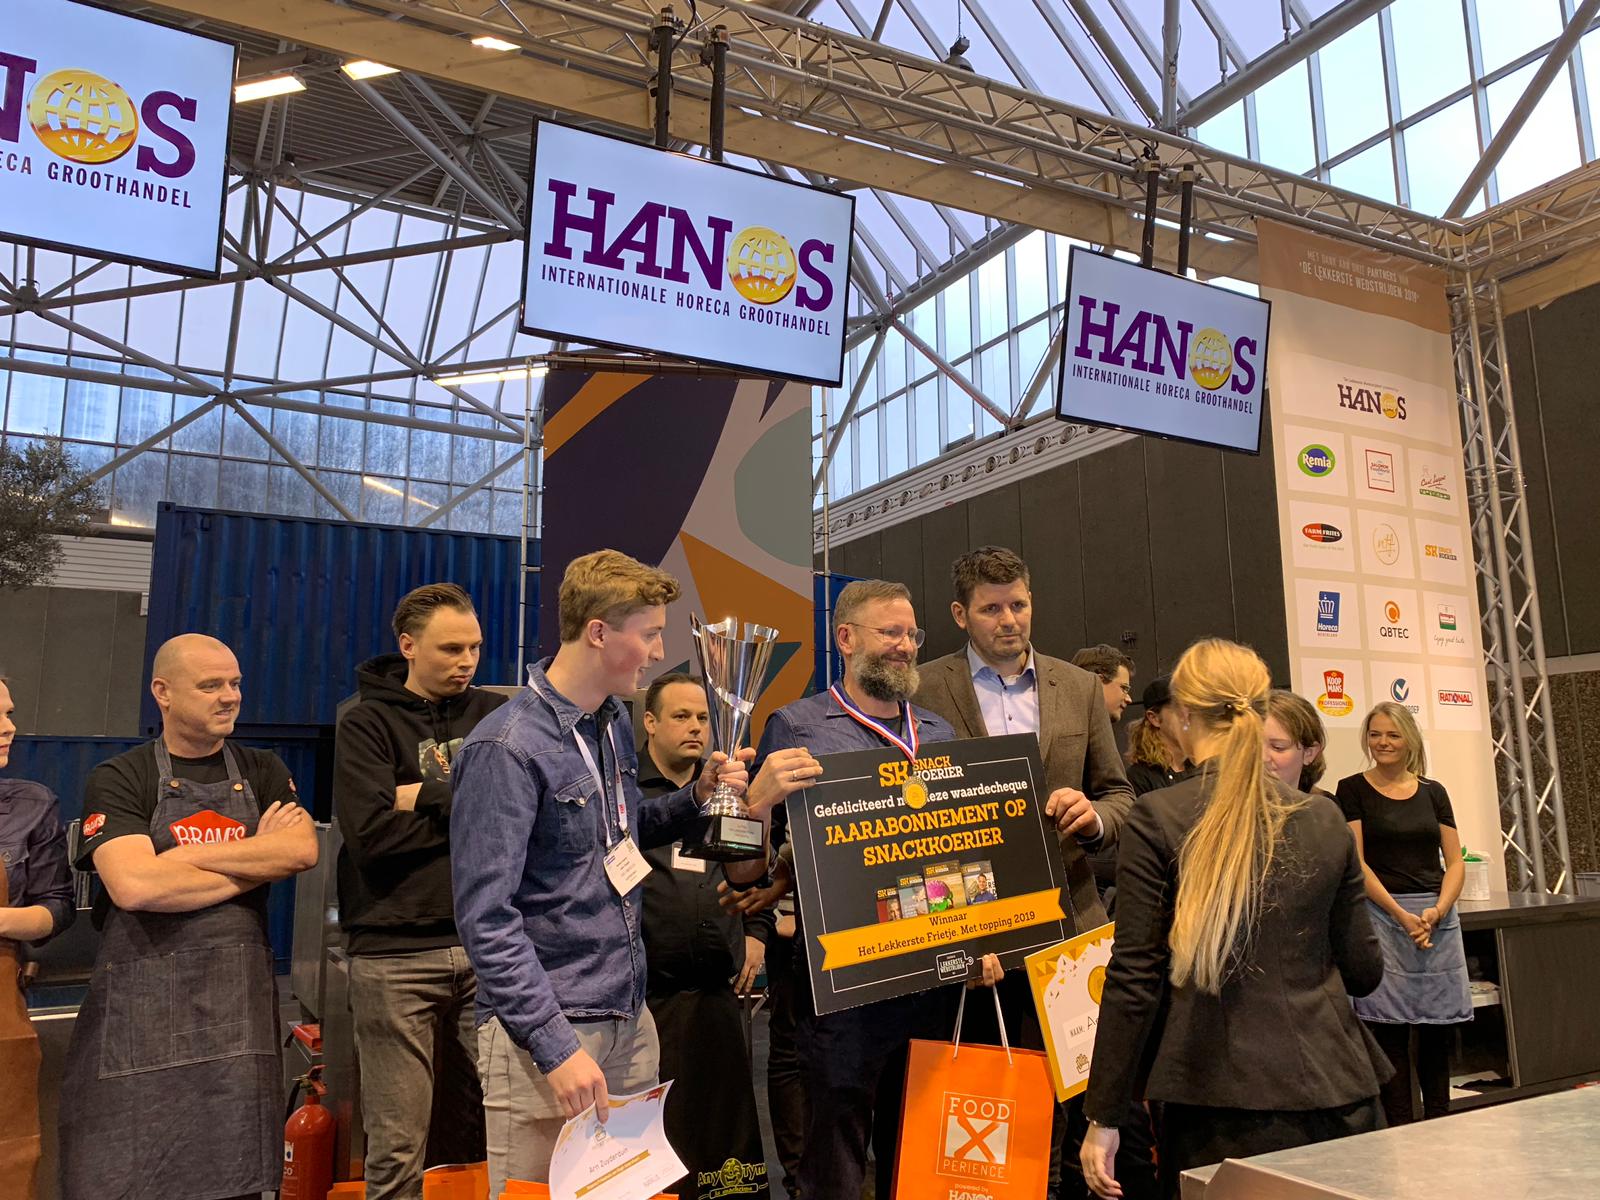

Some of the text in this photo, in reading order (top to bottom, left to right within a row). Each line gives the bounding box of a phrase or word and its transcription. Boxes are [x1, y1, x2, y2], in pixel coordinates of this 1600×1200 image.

[47, 161, 192, 209] GROOTHANDEL
[543, 178, 835, 312] HANOS
[1314, 264, 1354, 286] LEKKERSTE
[1355, 276, 1403, 298] WEDSTRIJDEN
[541, 264, 831, 336] INTERNATIONALE HORECA GROOTHANDEL
[1074, 295, 1257, 395] HANOS
[1072, 363, 1253, 414] INTERNATIONALE HORECA GROOTHANDEL
[1337, 383, 1407, 420] HANOS
[1302, 453, 1332, 469] Remia
[1304, 527, 1341, 537] FARM FRITES
[1317, 622, 1338, 632] Horeca
[1379, 627, 1409, 640] QBTEC
[1326, 676, 1343, 685] KOOP
[1328, 684, 1343, 693] MANS
[1439, 692, 1472, 704] RATIONAL
[878, 756, 952, 787] SK SNACK
[814, 797, 895, 818] Gefeliciteerd
[950, 779, 1028, 801] waardecheque
[825, 799, 1027, 846] JAARABONNEMENT OP
[863, 827, 1004, 867] SNACKKOERIER
[857, 945, 875, 957] Het
[878, 935, 925, 953] Lekkerste
[960, 923, 978, 936] Met
[979, 917, 1013, 936] topping
[1014, 910, 1036, 924] 2019
[929, 912, 967, 927] Winnaar
[948, 1096, 1010, 1120] FOOD
[697, 1170, 722, 1187] Any
[943, 1160, 1006, 1179] PERIENCE
